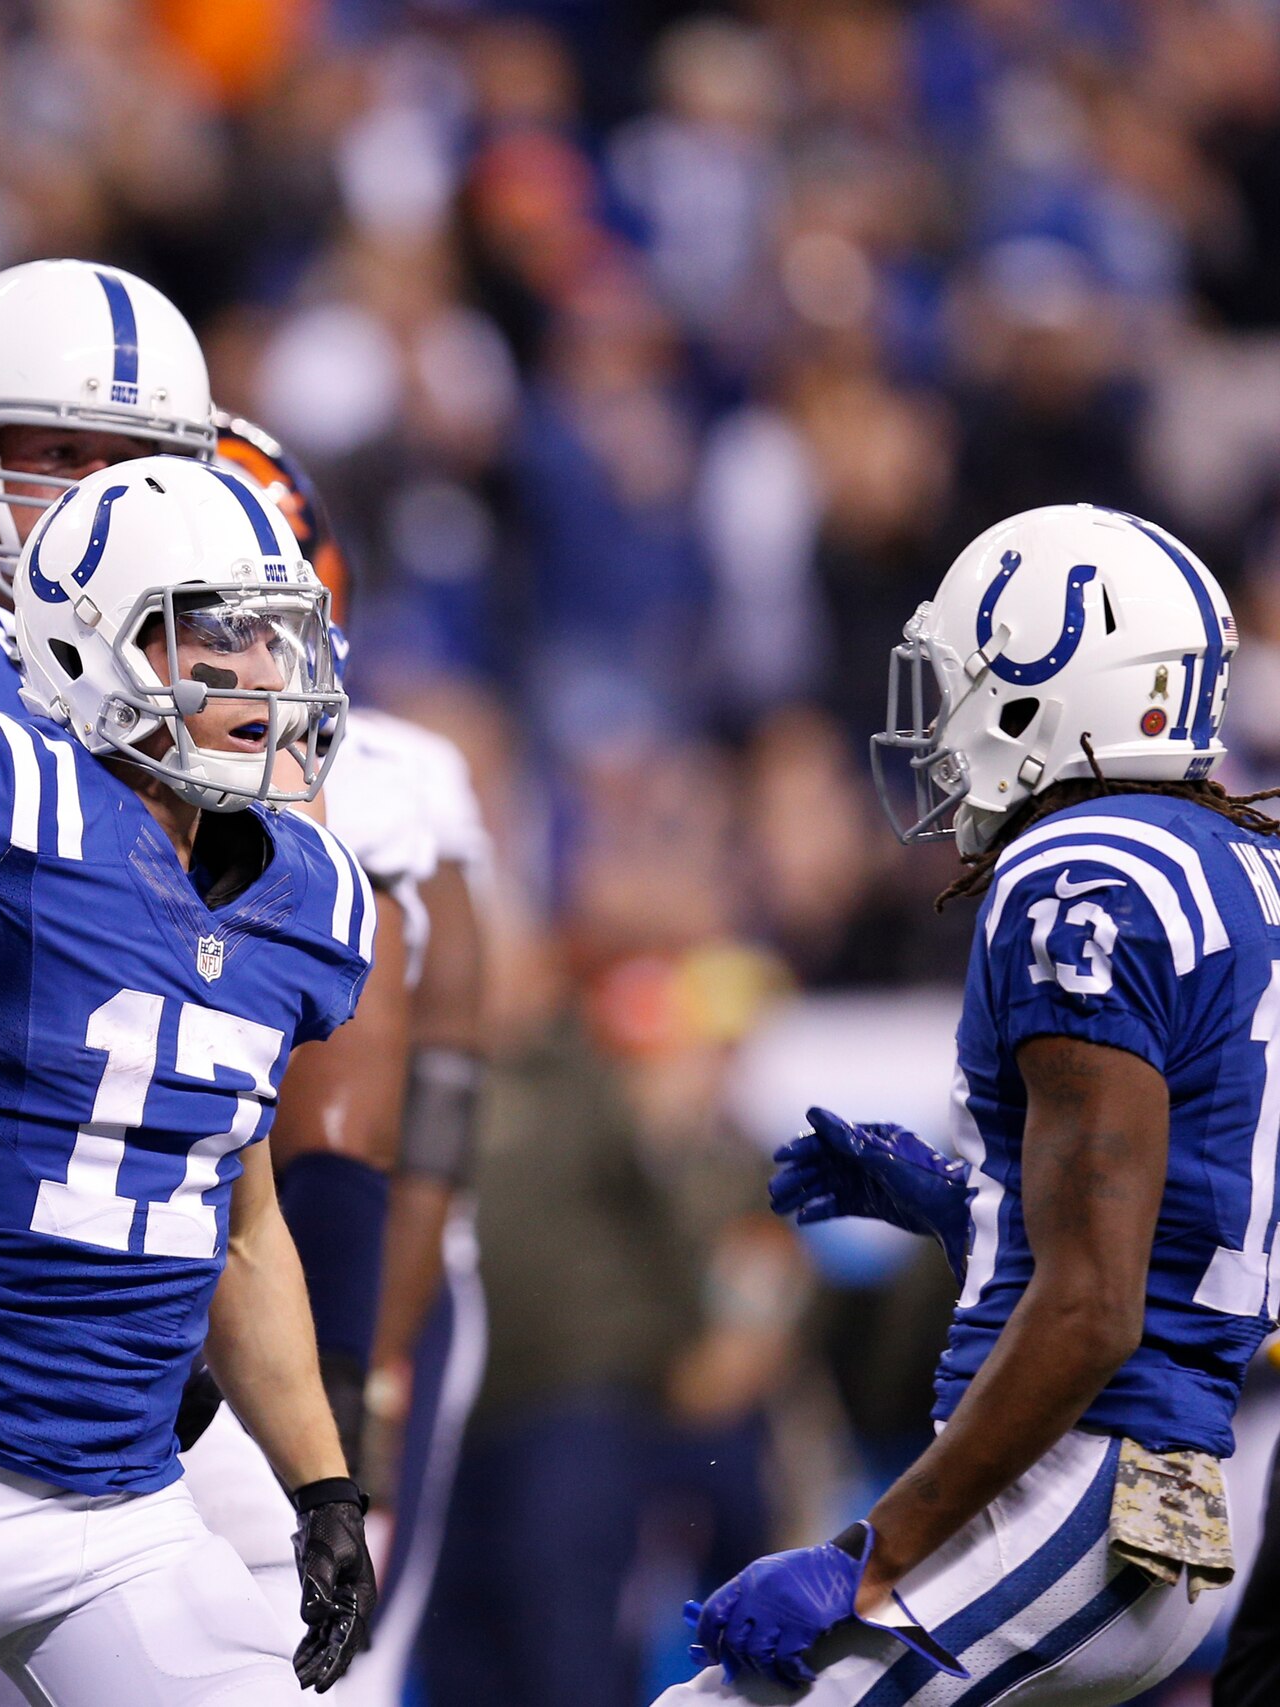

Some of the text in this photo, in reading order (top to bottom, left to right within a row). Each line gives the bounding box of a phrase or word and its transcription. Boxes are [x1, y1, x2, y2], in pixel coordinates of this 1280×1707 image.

[264, 564, 288, 582] COLTS
[201, 954, 218, 974] NFL
[1027, 898, 1119, 994] 13
[29, 988, 285, 1259] 17
